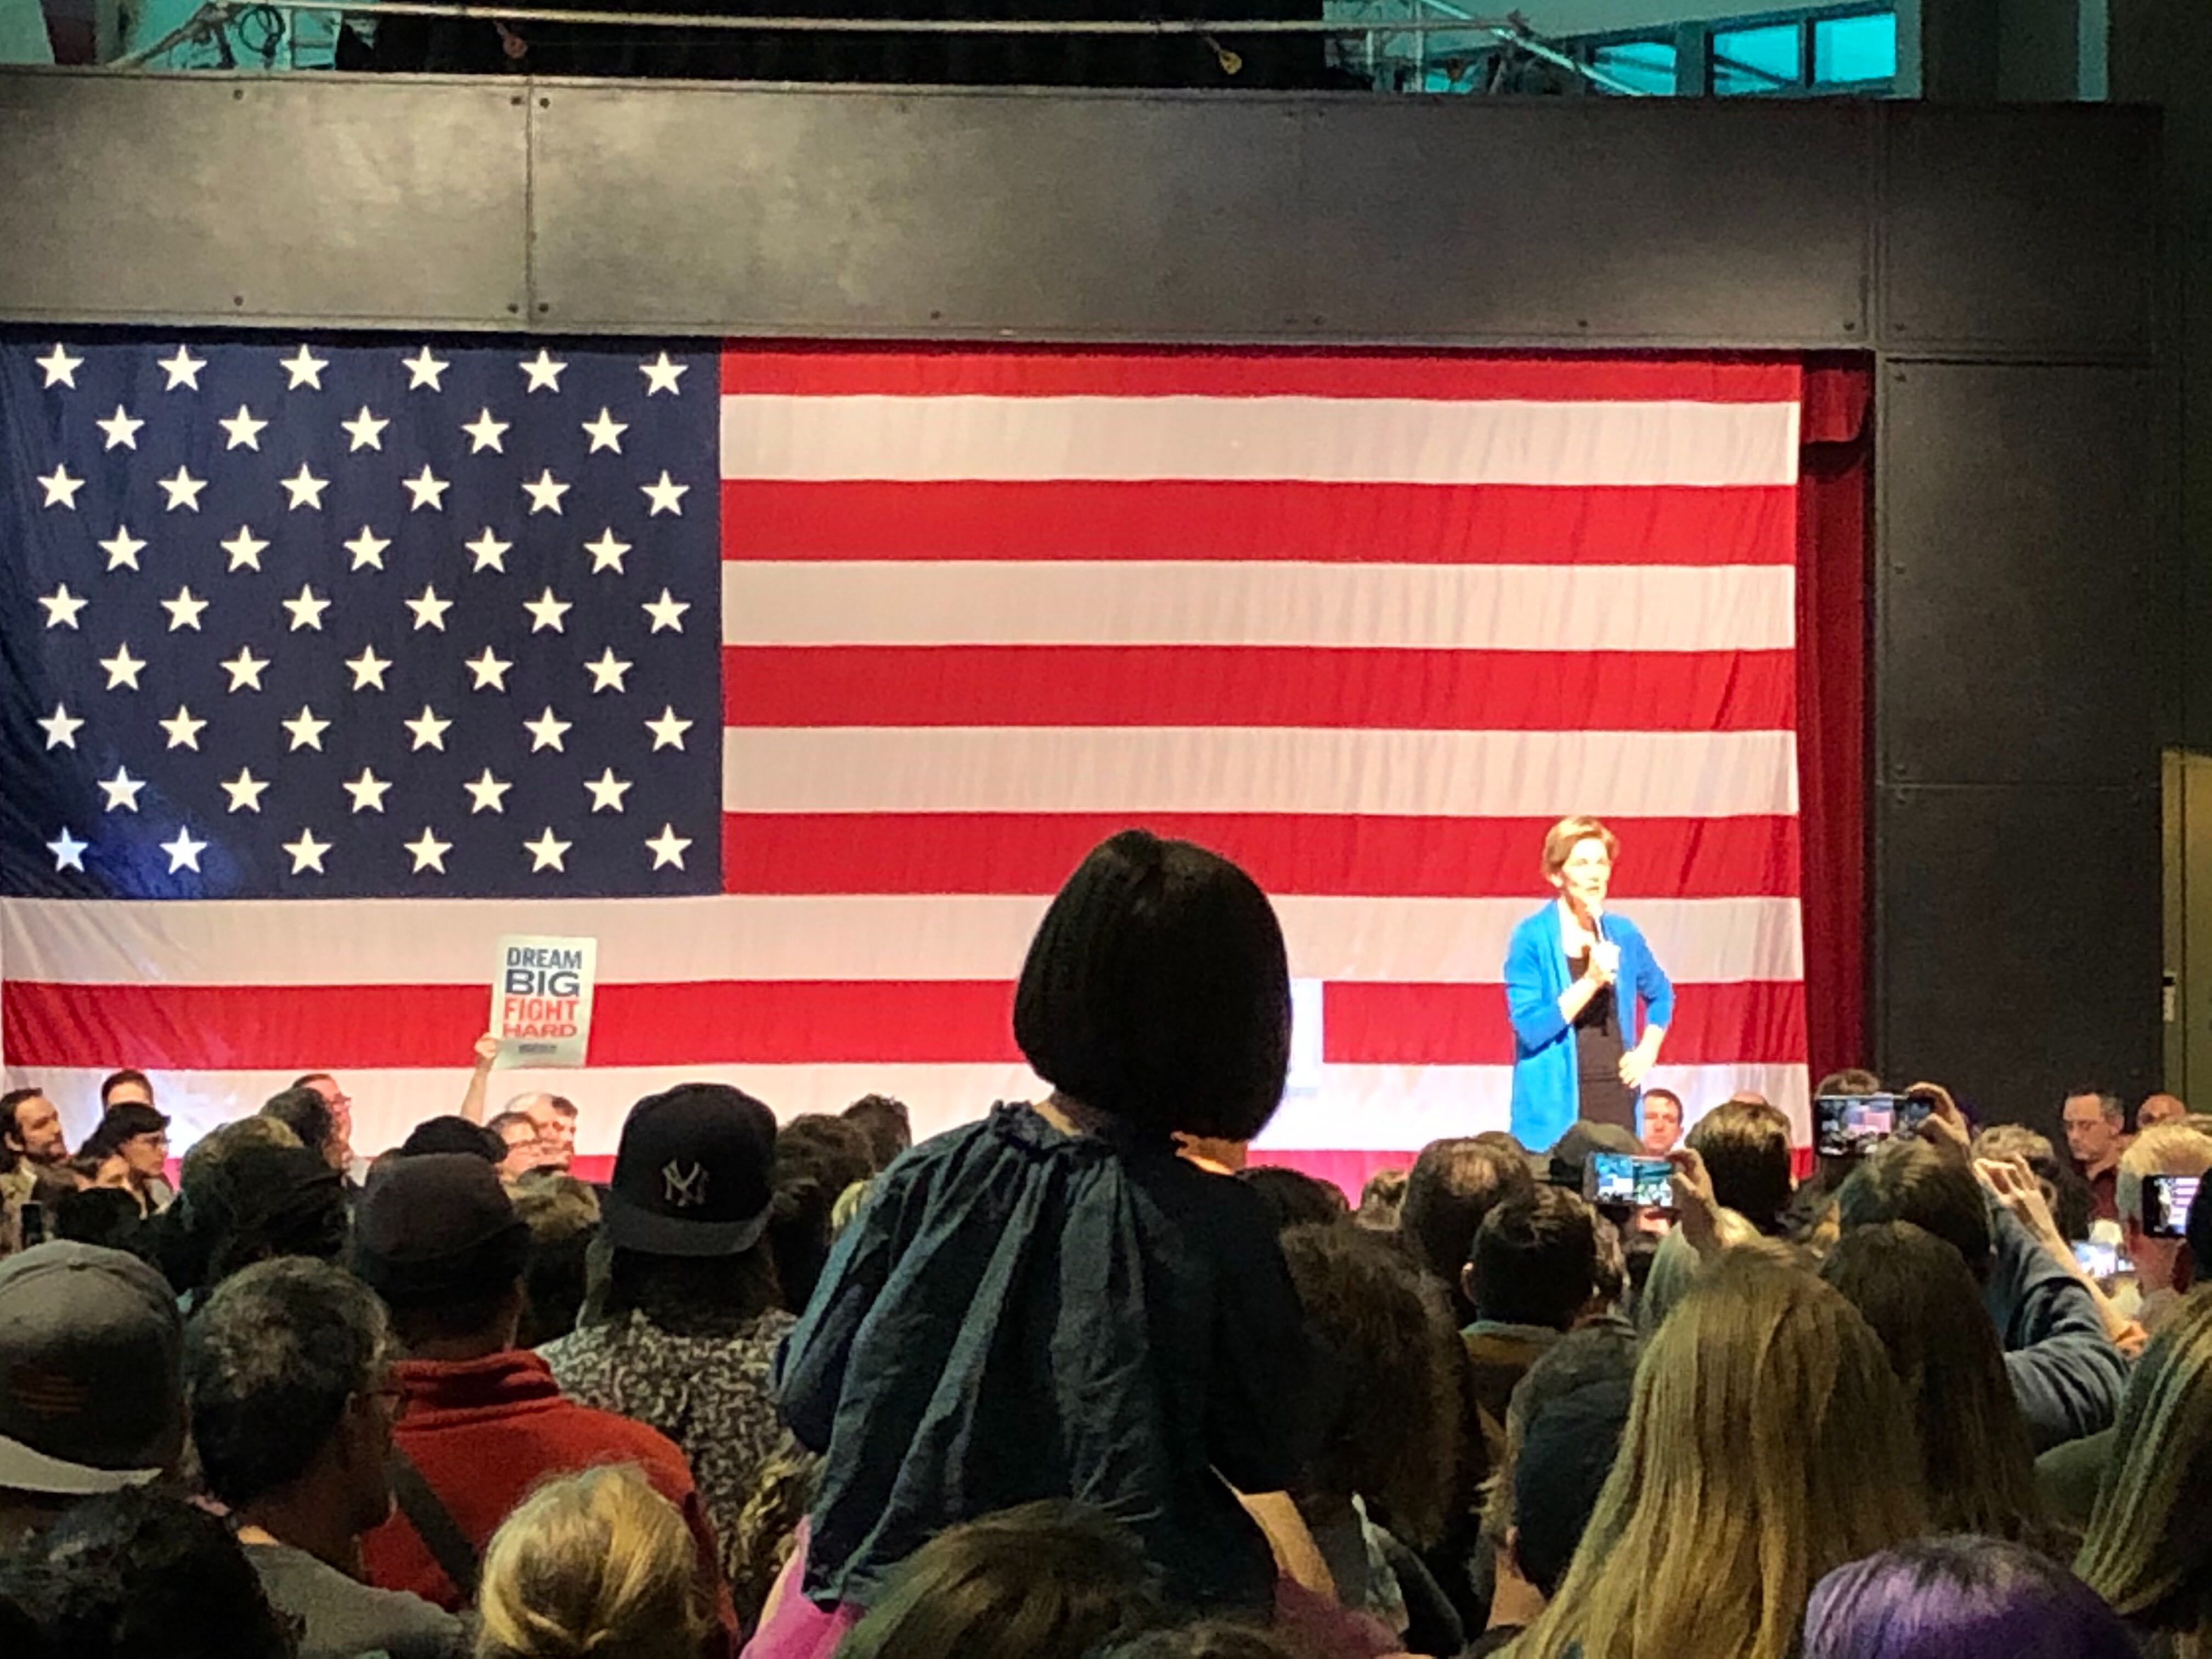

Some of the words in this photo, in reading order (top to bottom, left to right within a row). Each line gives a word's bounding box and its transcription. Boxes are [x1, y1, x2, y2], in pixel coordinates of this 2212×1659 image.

[507, 947, 582, 969] DREAM
[505, 969, 580, 997] BIG
[504, 998, 579, 1020] FIGHT
[503, 1024, 578, 1037] HARD
[662, 1159, 709, 1206] NY
